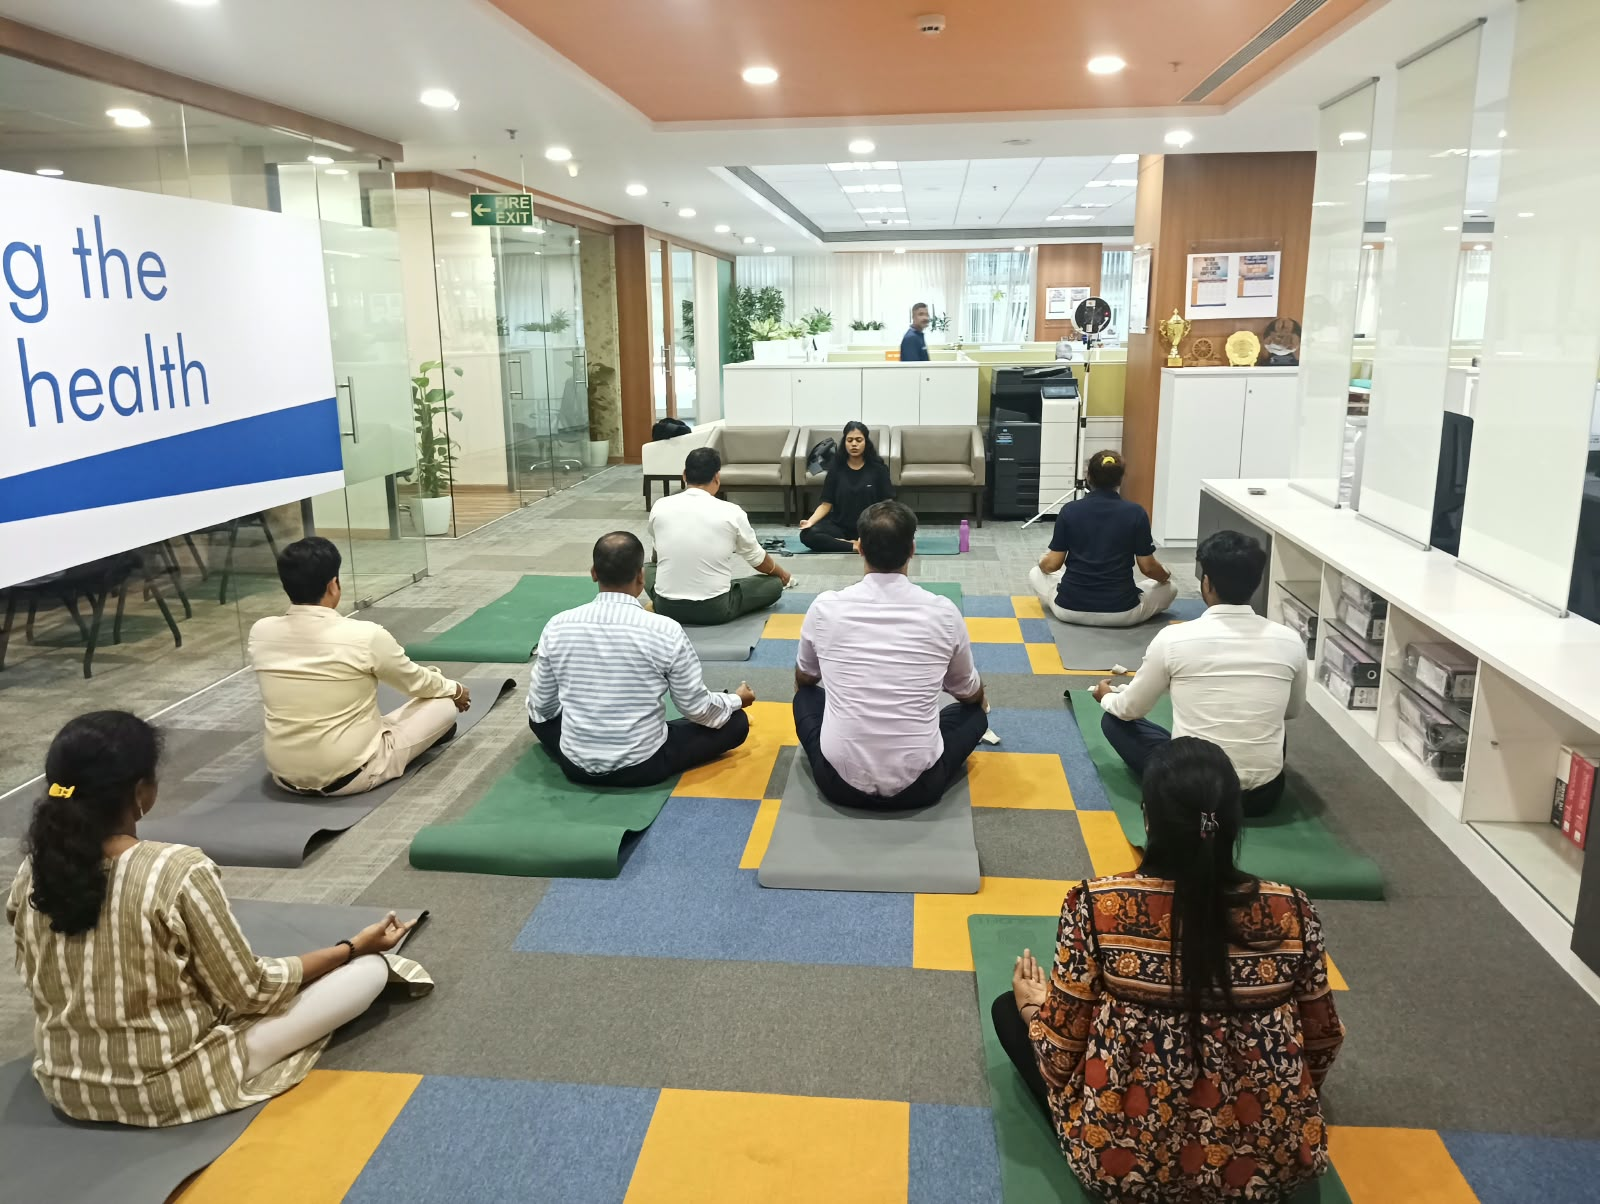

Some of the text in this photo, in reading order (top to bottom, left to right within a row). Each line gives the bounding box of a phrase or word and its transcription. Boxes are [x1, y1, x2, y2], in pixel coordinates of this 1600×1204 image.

[495, 196, 530, 209] FIRE
[495, 211, 530, 224] EXIT
[72, 214, 168, 302] the
[16, 332, 210, 428] health
